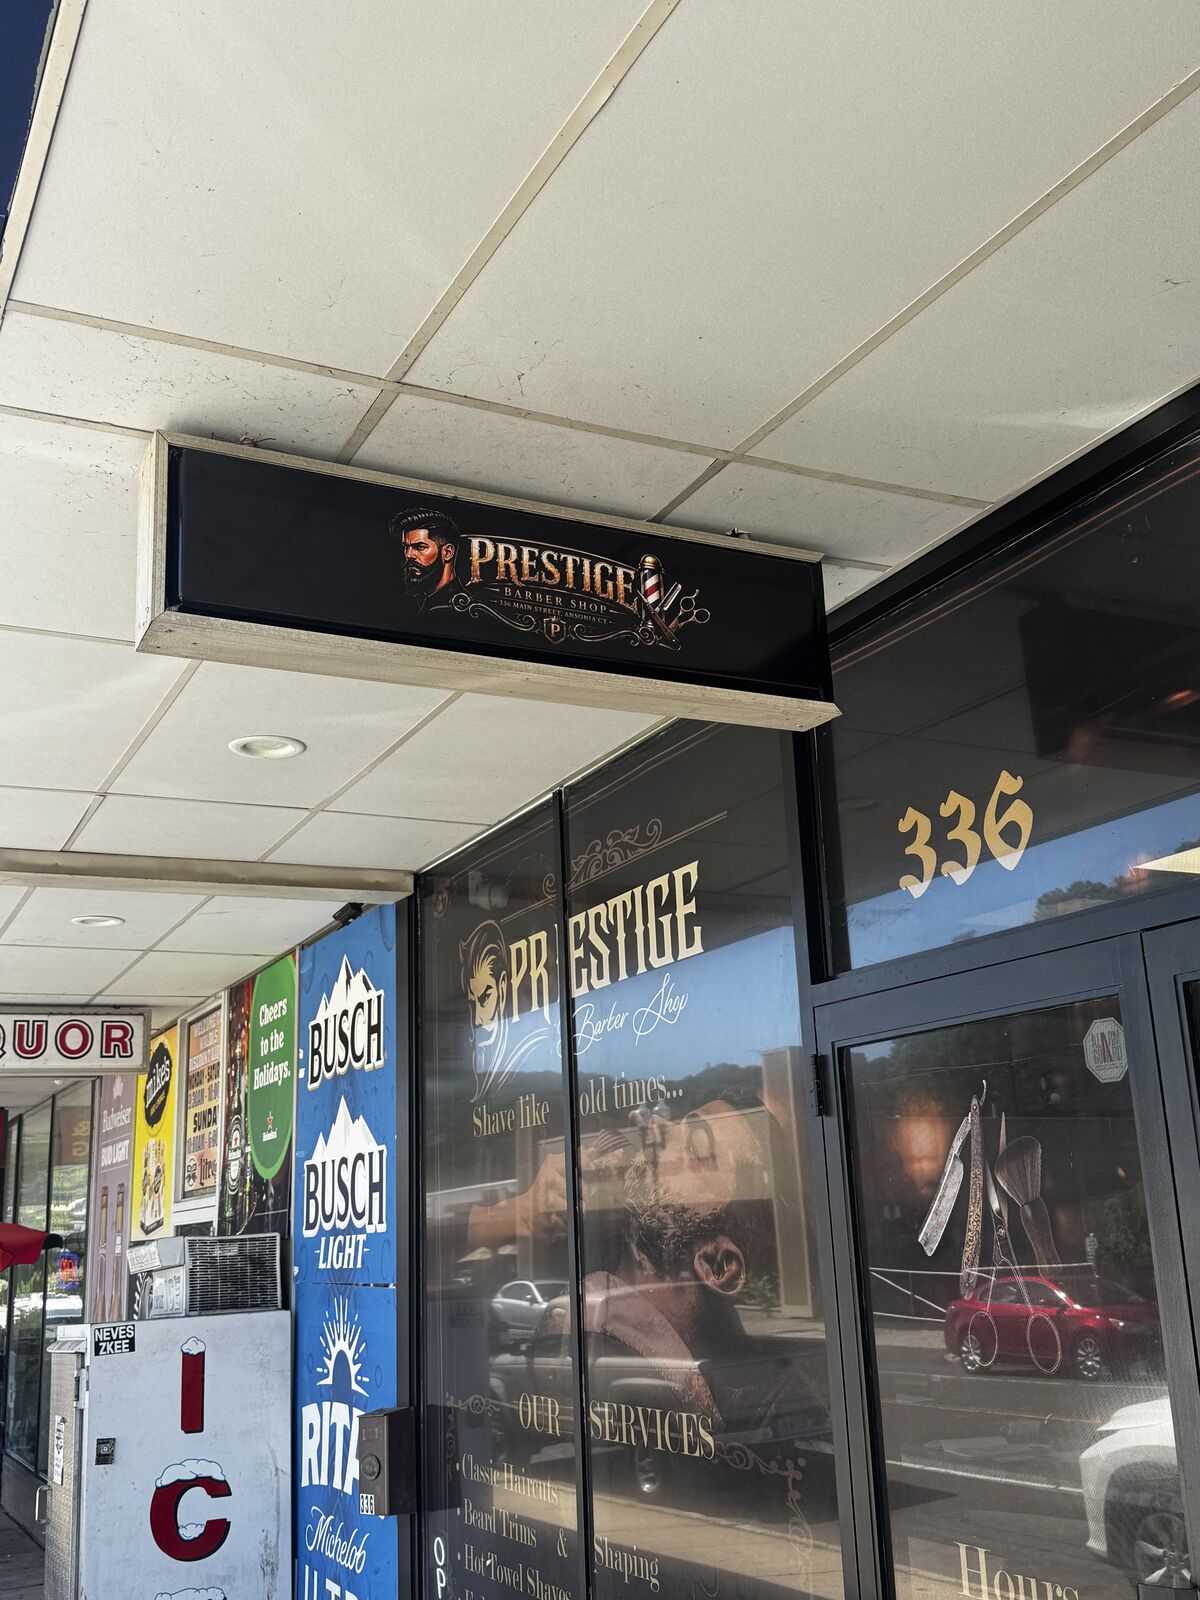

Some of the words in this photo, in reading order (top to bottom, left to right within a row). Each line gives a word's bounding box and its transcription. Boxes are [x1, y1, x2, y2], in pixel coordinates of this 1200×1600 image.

[467, 536, 638, 613] PRESTIGE
[499, 599, 512, 608] 336
[513, 602, 533, 611] MAIN
[564, 611, 597, 623] ANSONIA
[597, 616, 608, 625] CT
[504, 586, 563, 607] BARBER
[570, 599, 608, 614] SHOP
[551, 623, 561, 638] P
[898, 770, 1033, 899] 336
[259, 998, 288, 1028] Cheers
[572, 1001, 629, 1056] Barber
[632, 973, 689, 1047] Shop
[0, 1018, 134, 1060] UOR
[260, 1036, 269, 1057] to
[269, 1028, 285, 1053] the
[308, 991, 384, 1088] BUSCH
[253, 1060, 291, 1091] Holidays.
[102, 1104, 132, 1133] Budweiser
[472, 1104, 515, 1138] Shave
[519, 1093, 550, 1128] like
[579, 1079, 608, 1118] old
[304, 1147, 385, 1233] BUSCH
[318, 1233, 367, 1269] LIGHT
[95, 1325, 134, 1342] NEVES
[99, 1339, 130, 1355] ZKEE
[301, 1401, 367, 1497] RITA
[518, 1392, 561, 1437] OUR
[589, 1399, 716, 1460] SERVICES
[462, 1452, 500, 1488] Classic
[503, 1462, 559, 1506] Haircuts
[360, 1494, 375, 1515] 336
[305, 1505, 370, 1574] Michelob
[463, 1498, 497, 1535] Beard
[499, 1508, 537, 1548] Trims
[557, 1527, 568, 1558] &
[593, 1535, 660, 1593] Shaping
[464, 1543, 486, 1577] Hot
[487, 1551, 524, 1593] Towel
